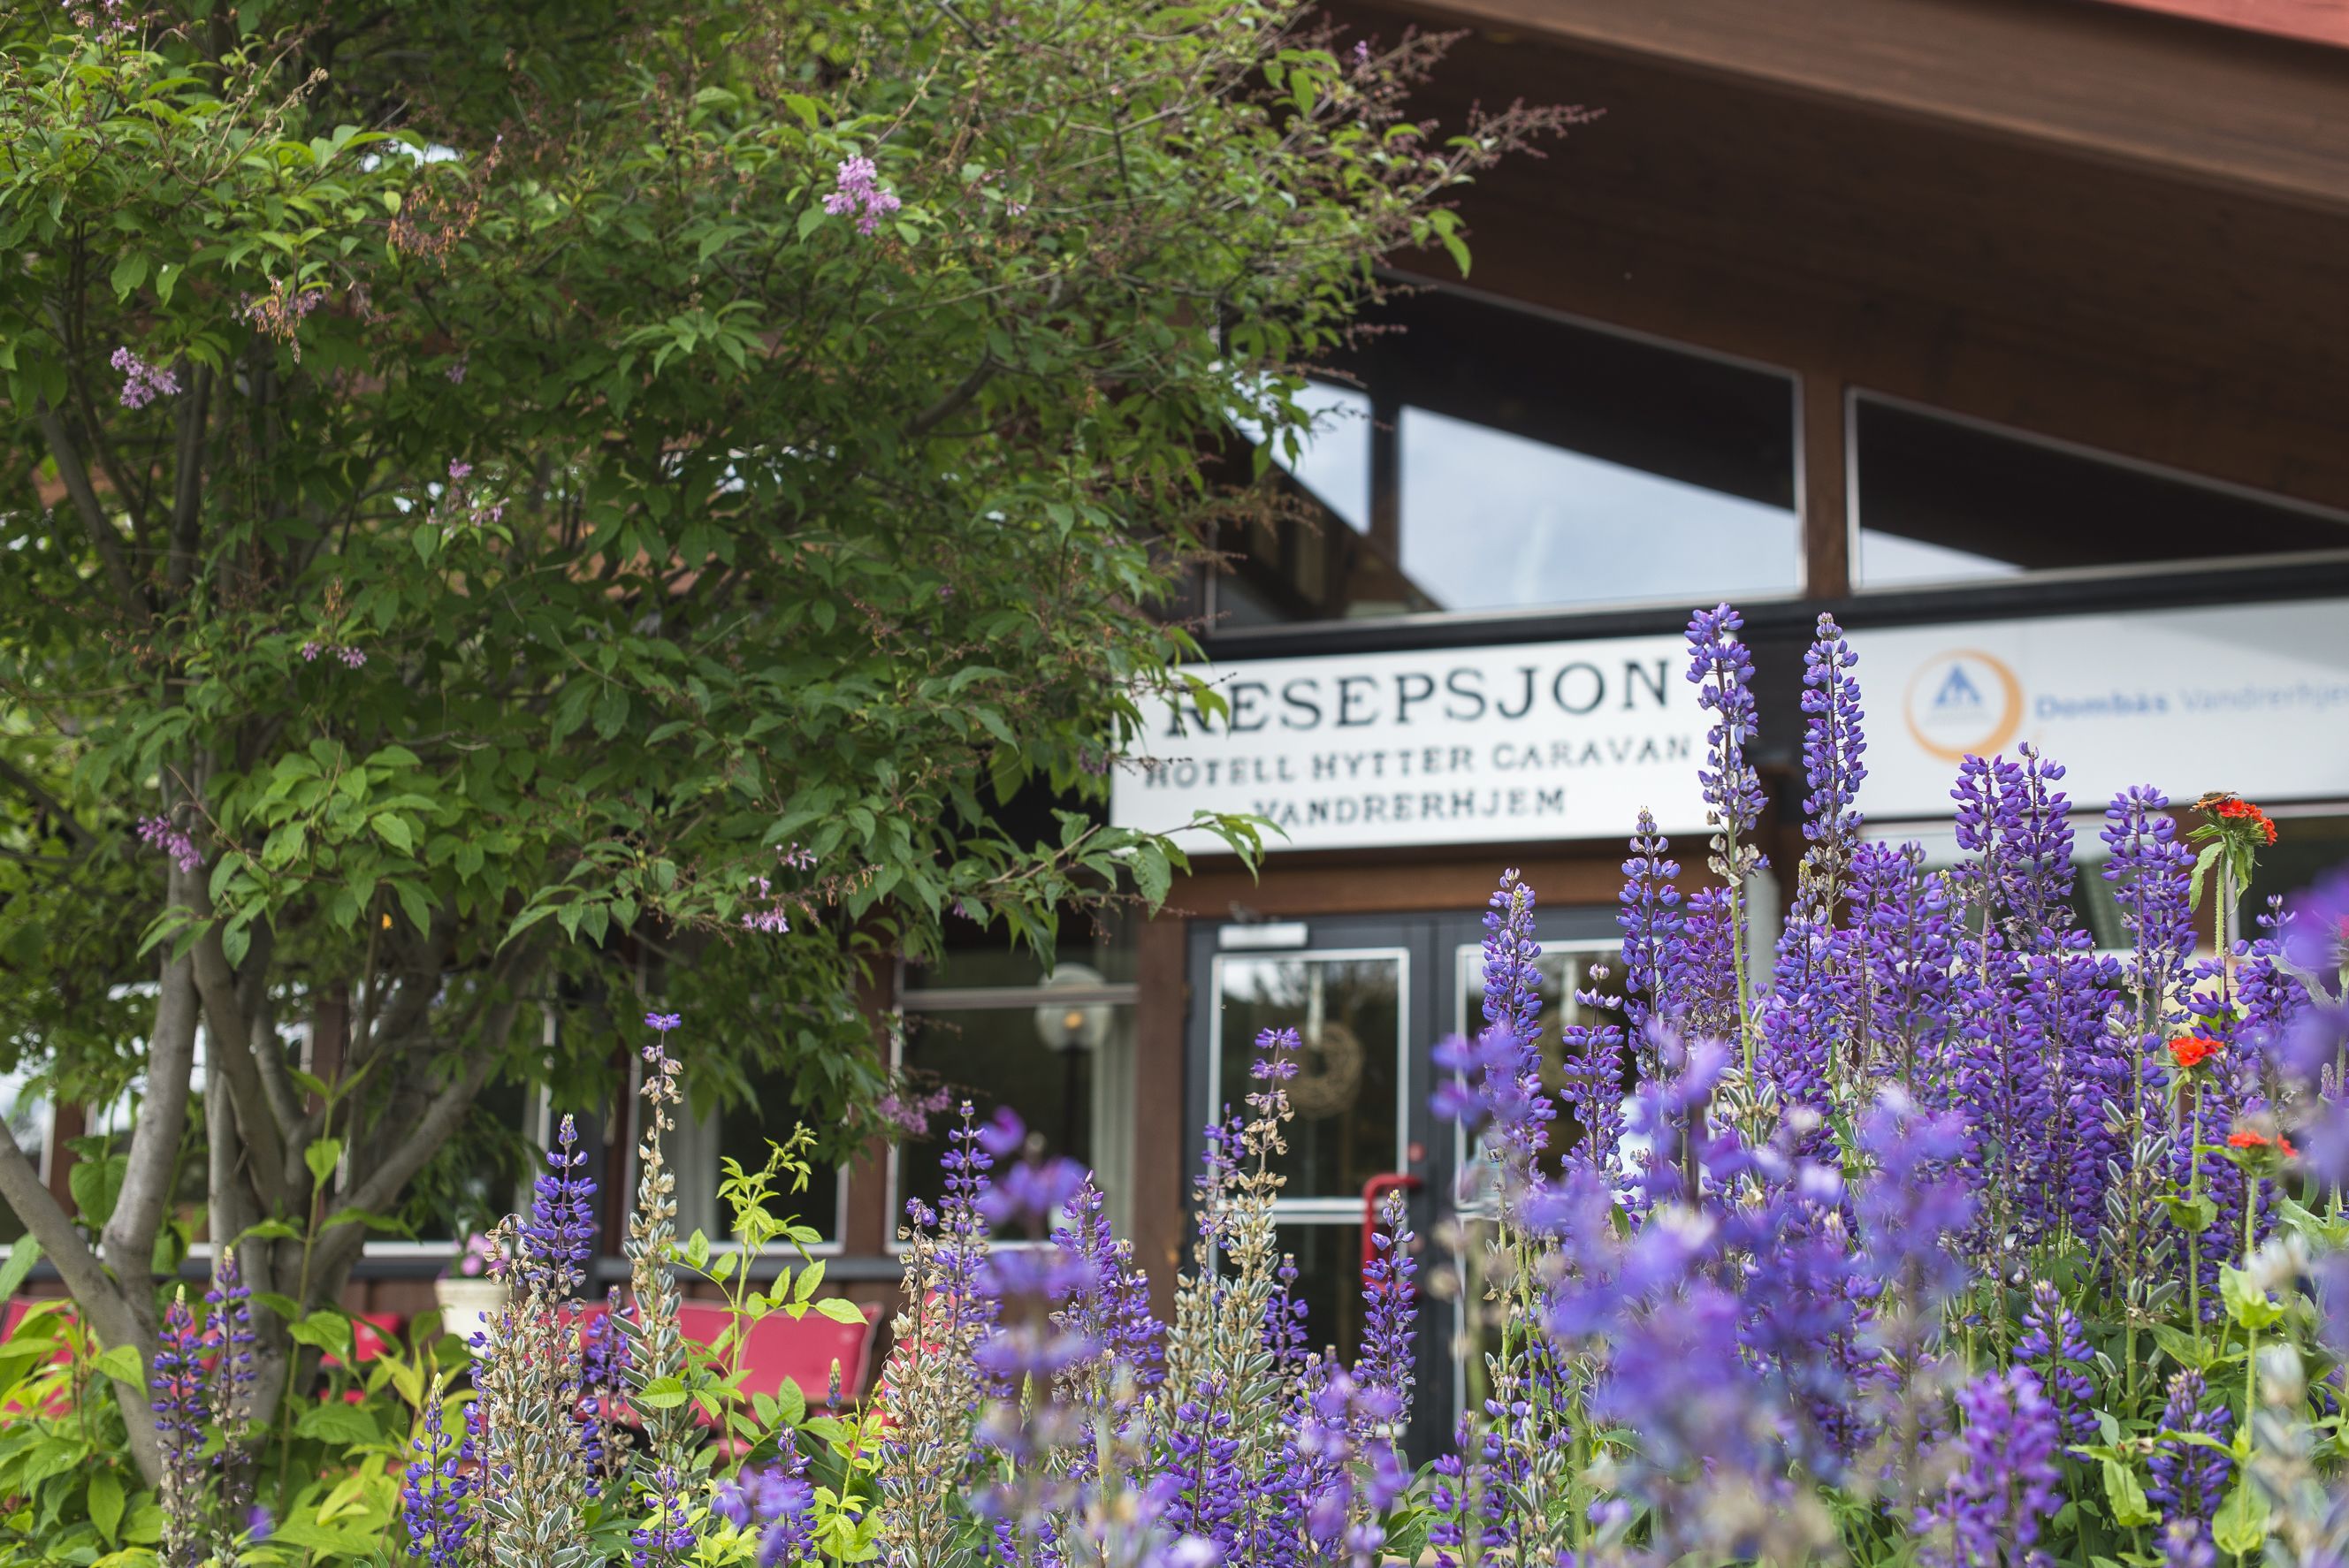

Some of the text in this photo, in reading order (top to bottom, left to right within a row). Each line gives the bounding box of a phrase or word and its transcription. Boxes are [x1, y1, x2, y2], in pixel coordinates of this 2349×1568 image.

[1145, 736, 1691, 788] HOTELL HYTTER CARAVAN
[1254, 788, 1566, 827] VANDRERHJEM
